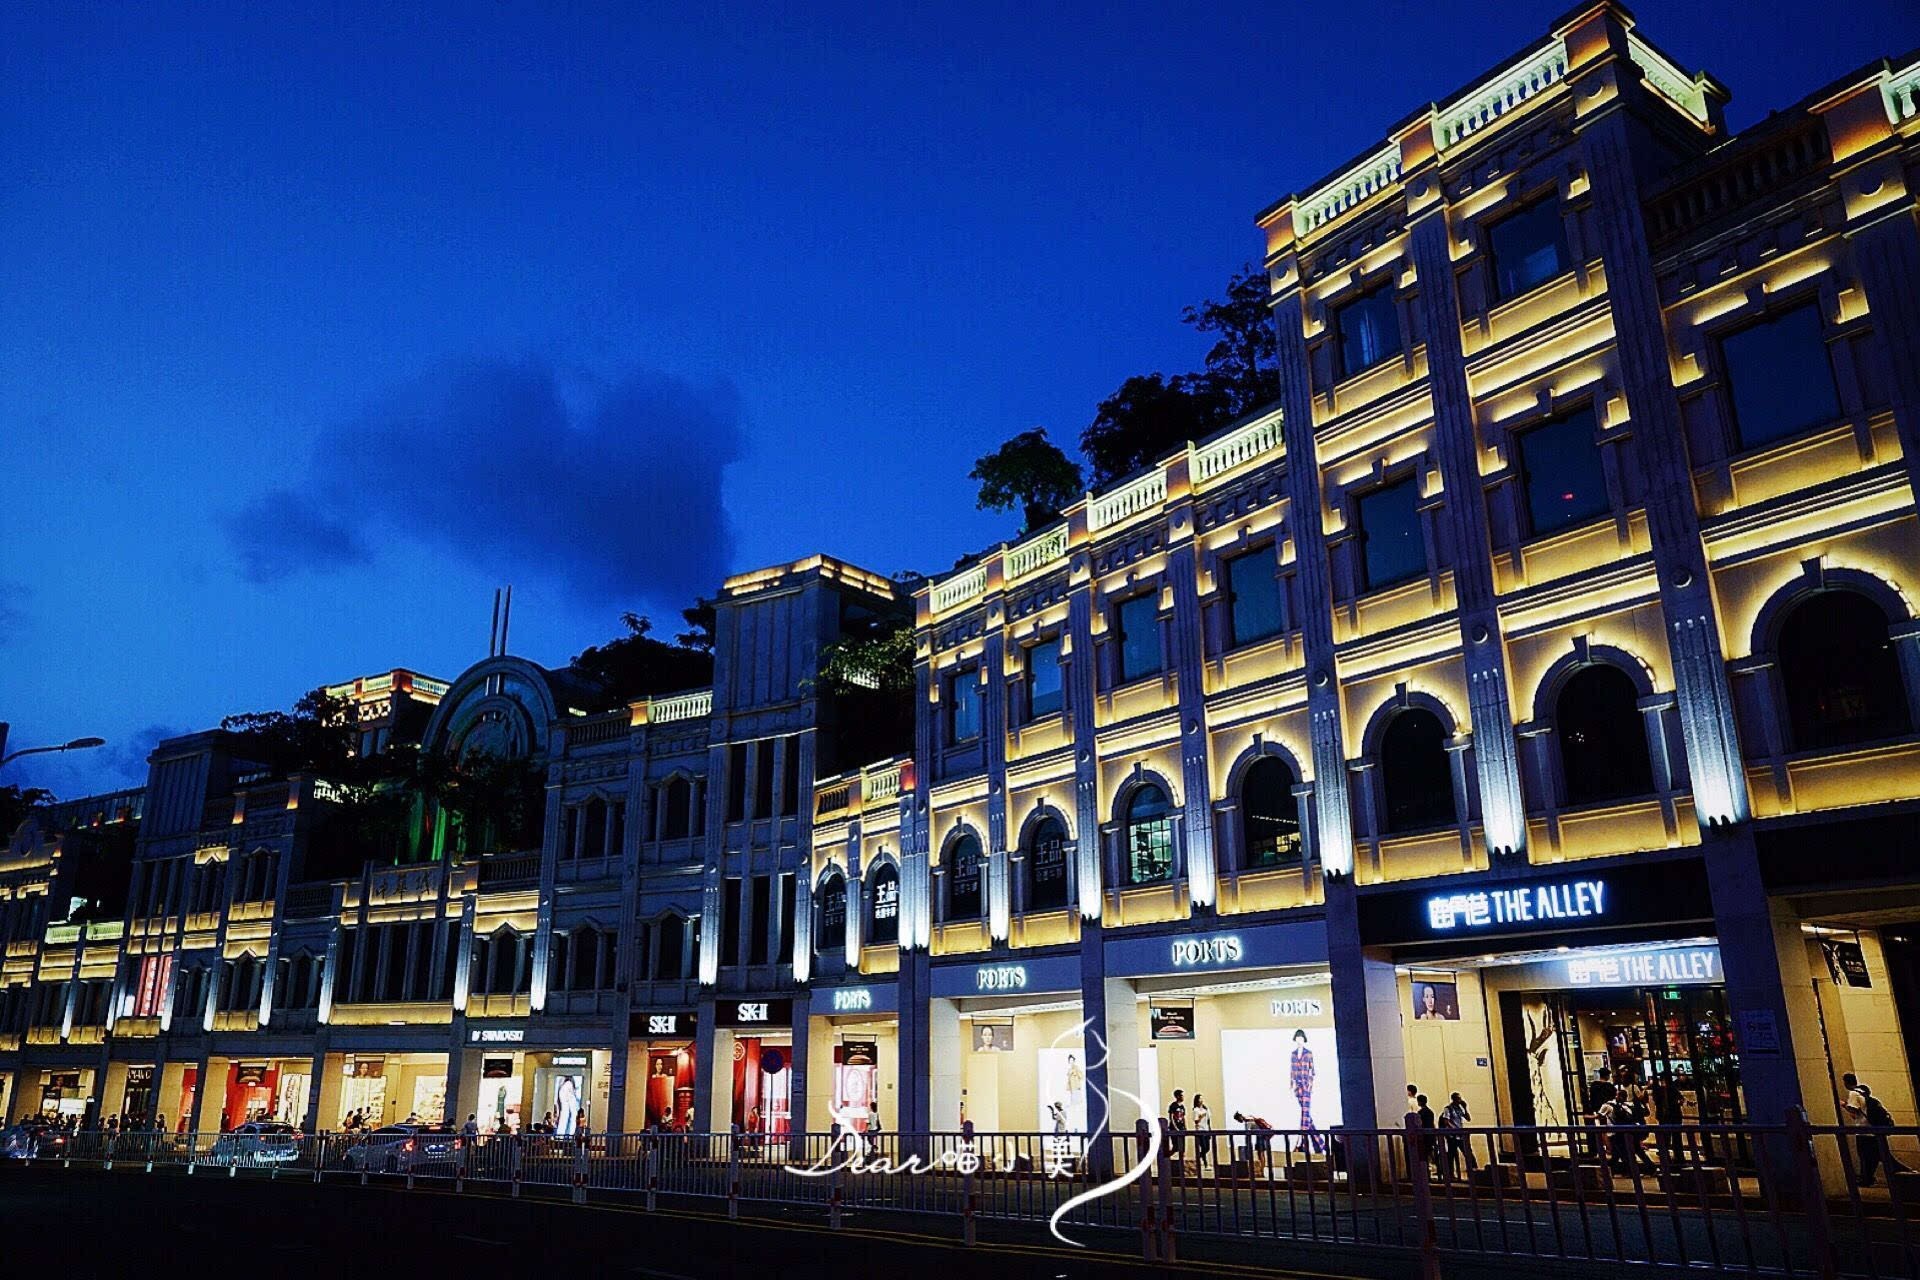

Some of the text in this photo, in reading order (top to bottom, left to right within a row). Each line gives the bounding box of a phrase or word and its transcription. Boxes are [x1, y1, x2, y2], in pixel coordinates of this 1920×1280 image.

[875, 881, 897, 904] 王品
[1490, 888, 1534, 923] THE
[1537, 881, 1604, 918] ALLEY
[1172, 937, 1242, 966] PORTS
[976, 965, 1027, 990] PORTS
[1621, 954, 1657, 981] THE
[1659, 951, 1714, 980] ALLEY
[834, 990, 872, 1011] PORTS
[1270, 998, 1322, 1017] PORTS
